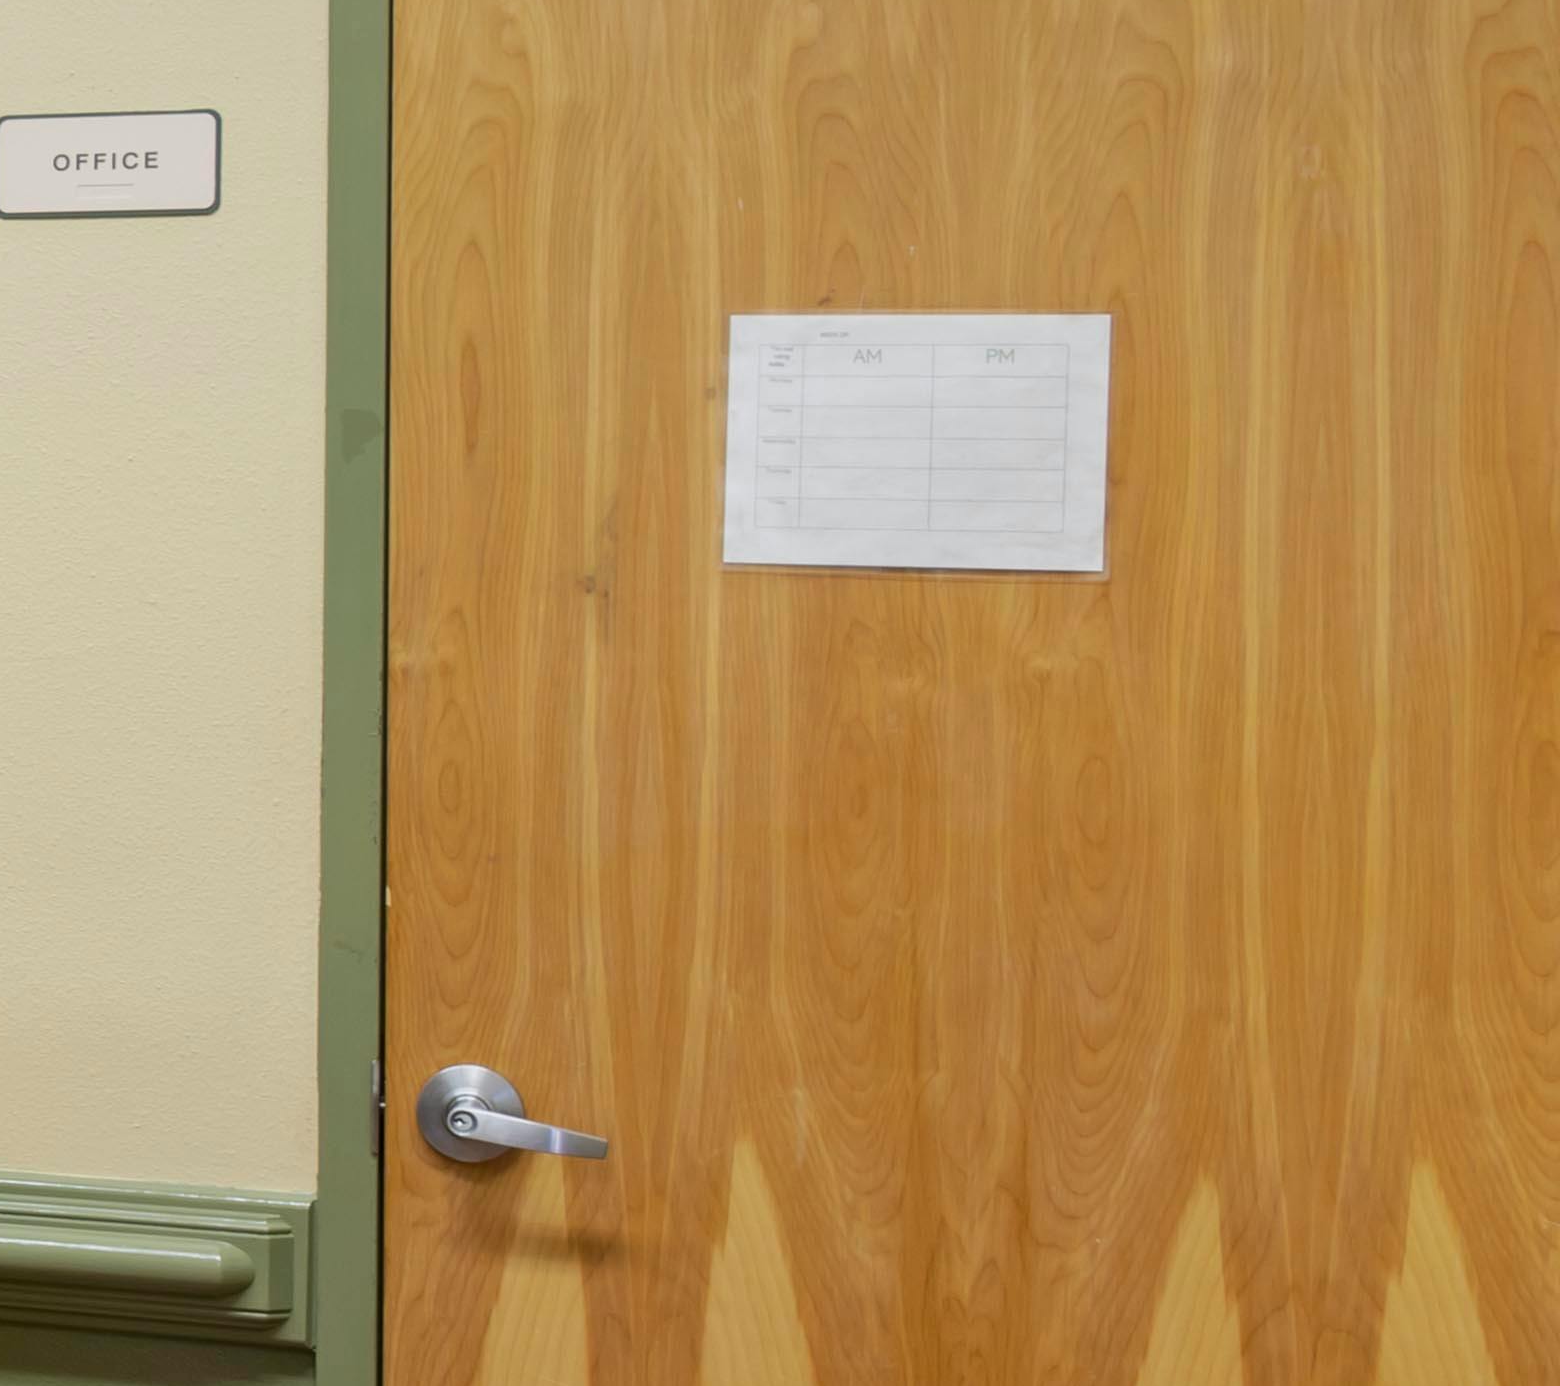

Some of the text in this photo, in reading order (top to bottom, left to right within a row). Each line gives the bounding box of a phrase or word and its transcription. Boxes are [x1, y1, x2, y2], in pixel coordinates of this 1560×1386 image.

[52, 151, 159, 171] OFFICE
[852, 348, 1015, 365] AM PM
